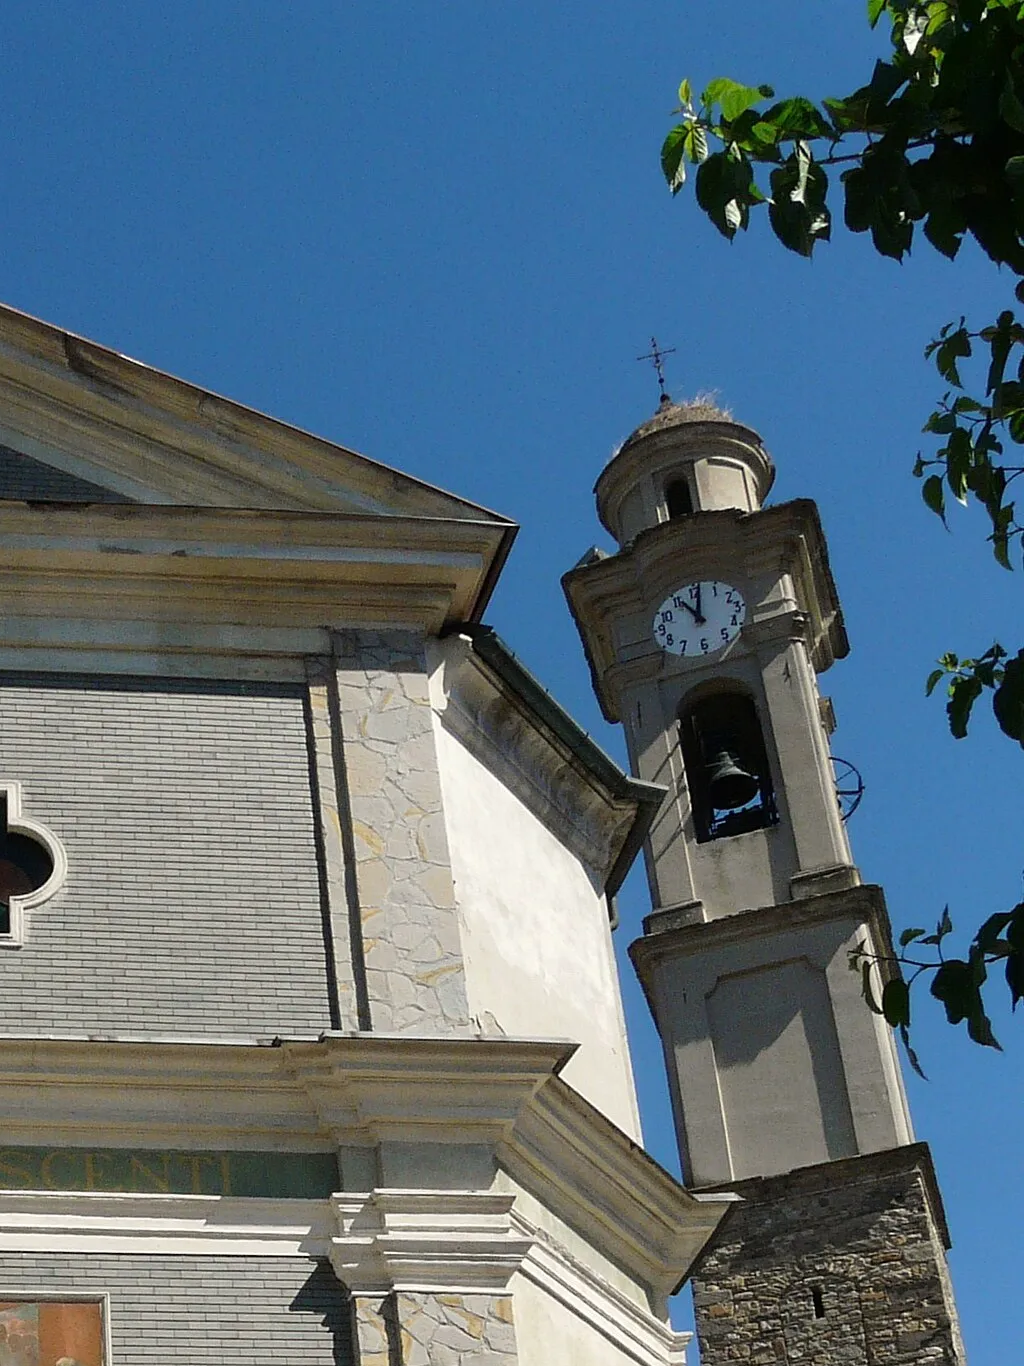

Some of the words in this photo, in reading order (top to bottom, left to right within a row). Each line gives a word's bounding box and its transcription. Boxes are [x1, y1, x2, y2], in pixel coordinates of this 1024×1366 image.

[712, 586, 717, 597] 1
[725, 591, 733, 603] 2
[733, 600, 741, 613] 3
[661, 610, 673, 623] 10
[658, 624, 666, 636] 9
[720, 628, 729, 640] 5
[666, 633, 674, 646] 8
[700, 639, 708, 650] 6
[680, 640, 687, 652] 7
